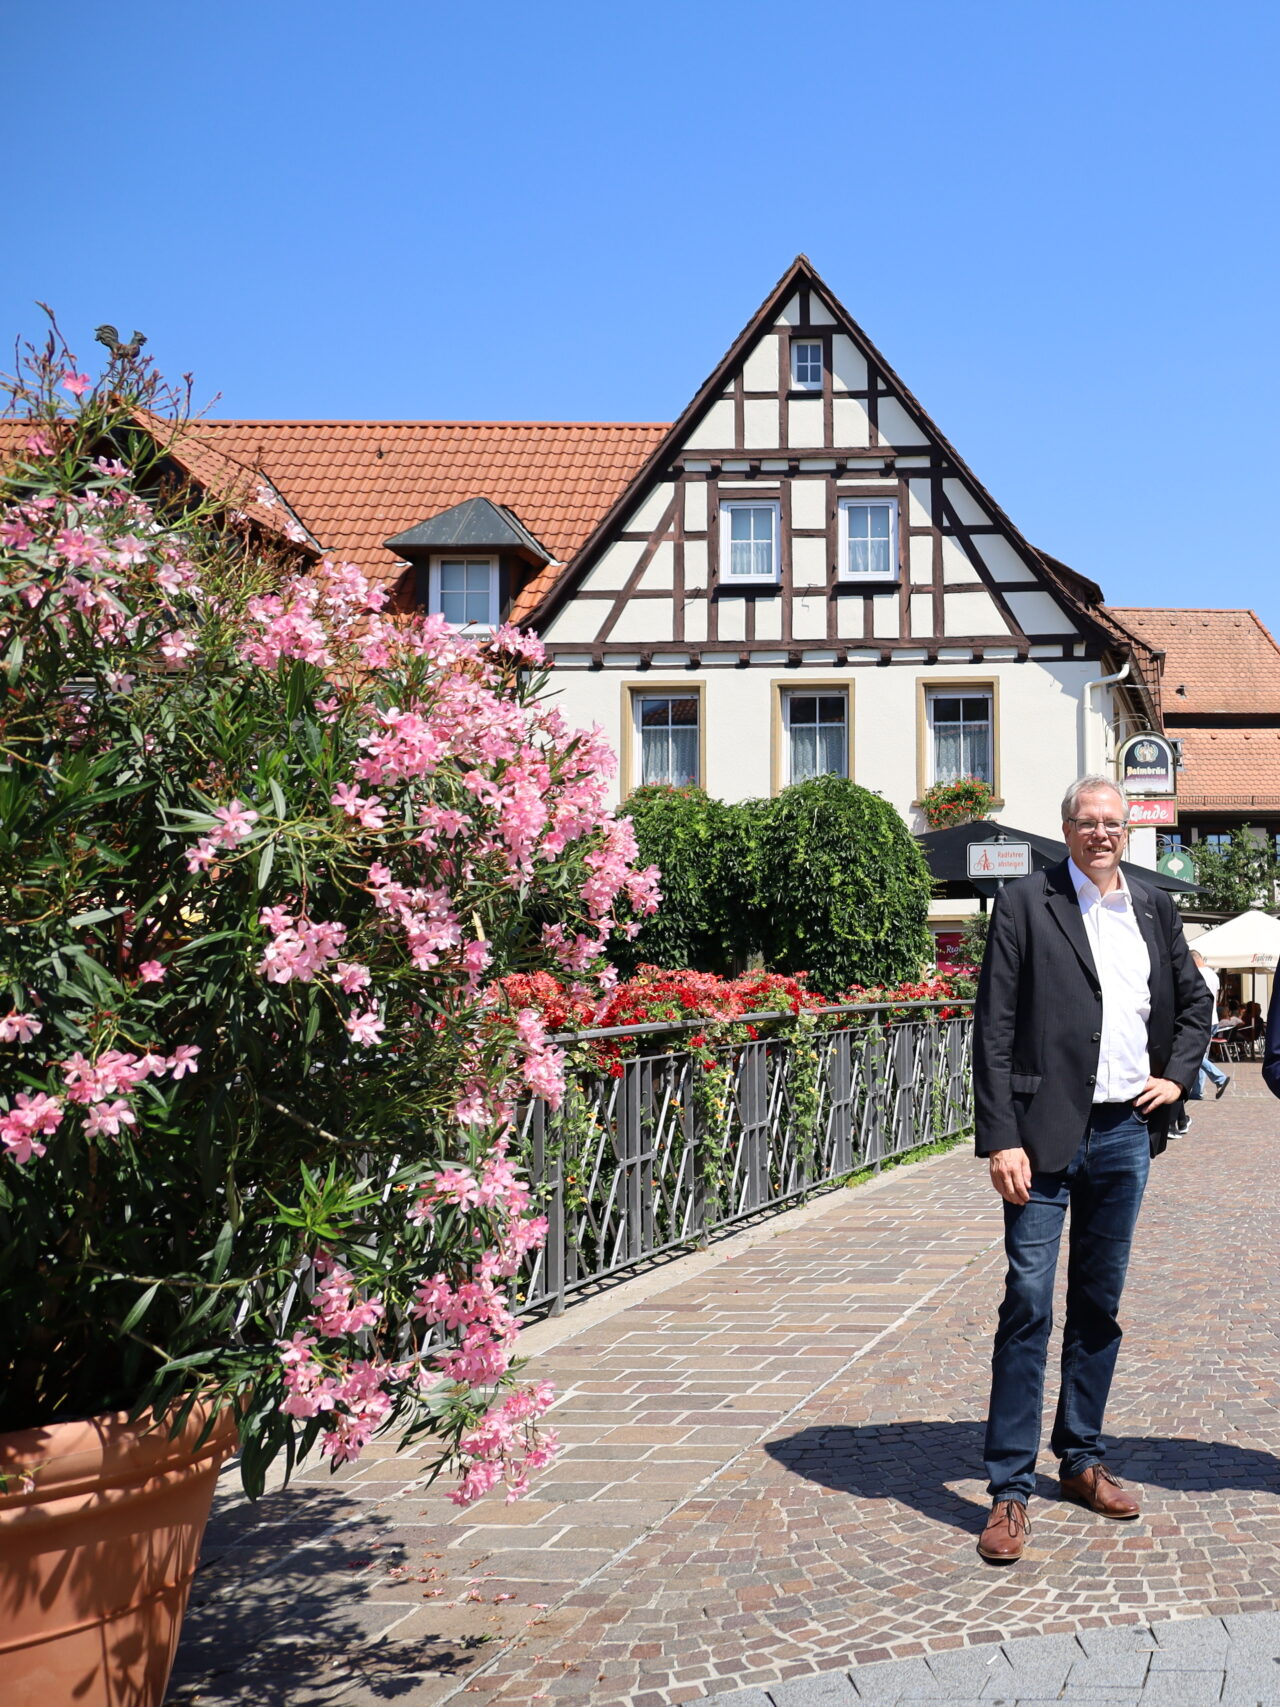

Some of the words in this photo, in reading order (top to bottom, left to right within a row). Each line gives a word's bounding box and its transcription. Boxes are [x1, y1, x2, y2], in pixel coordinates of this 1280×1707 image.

[1129, 804, 1169, 822] Linde
[997, 851, 1024, 859] Radfahrer
[997, 861, 1024, 870] absteigen
